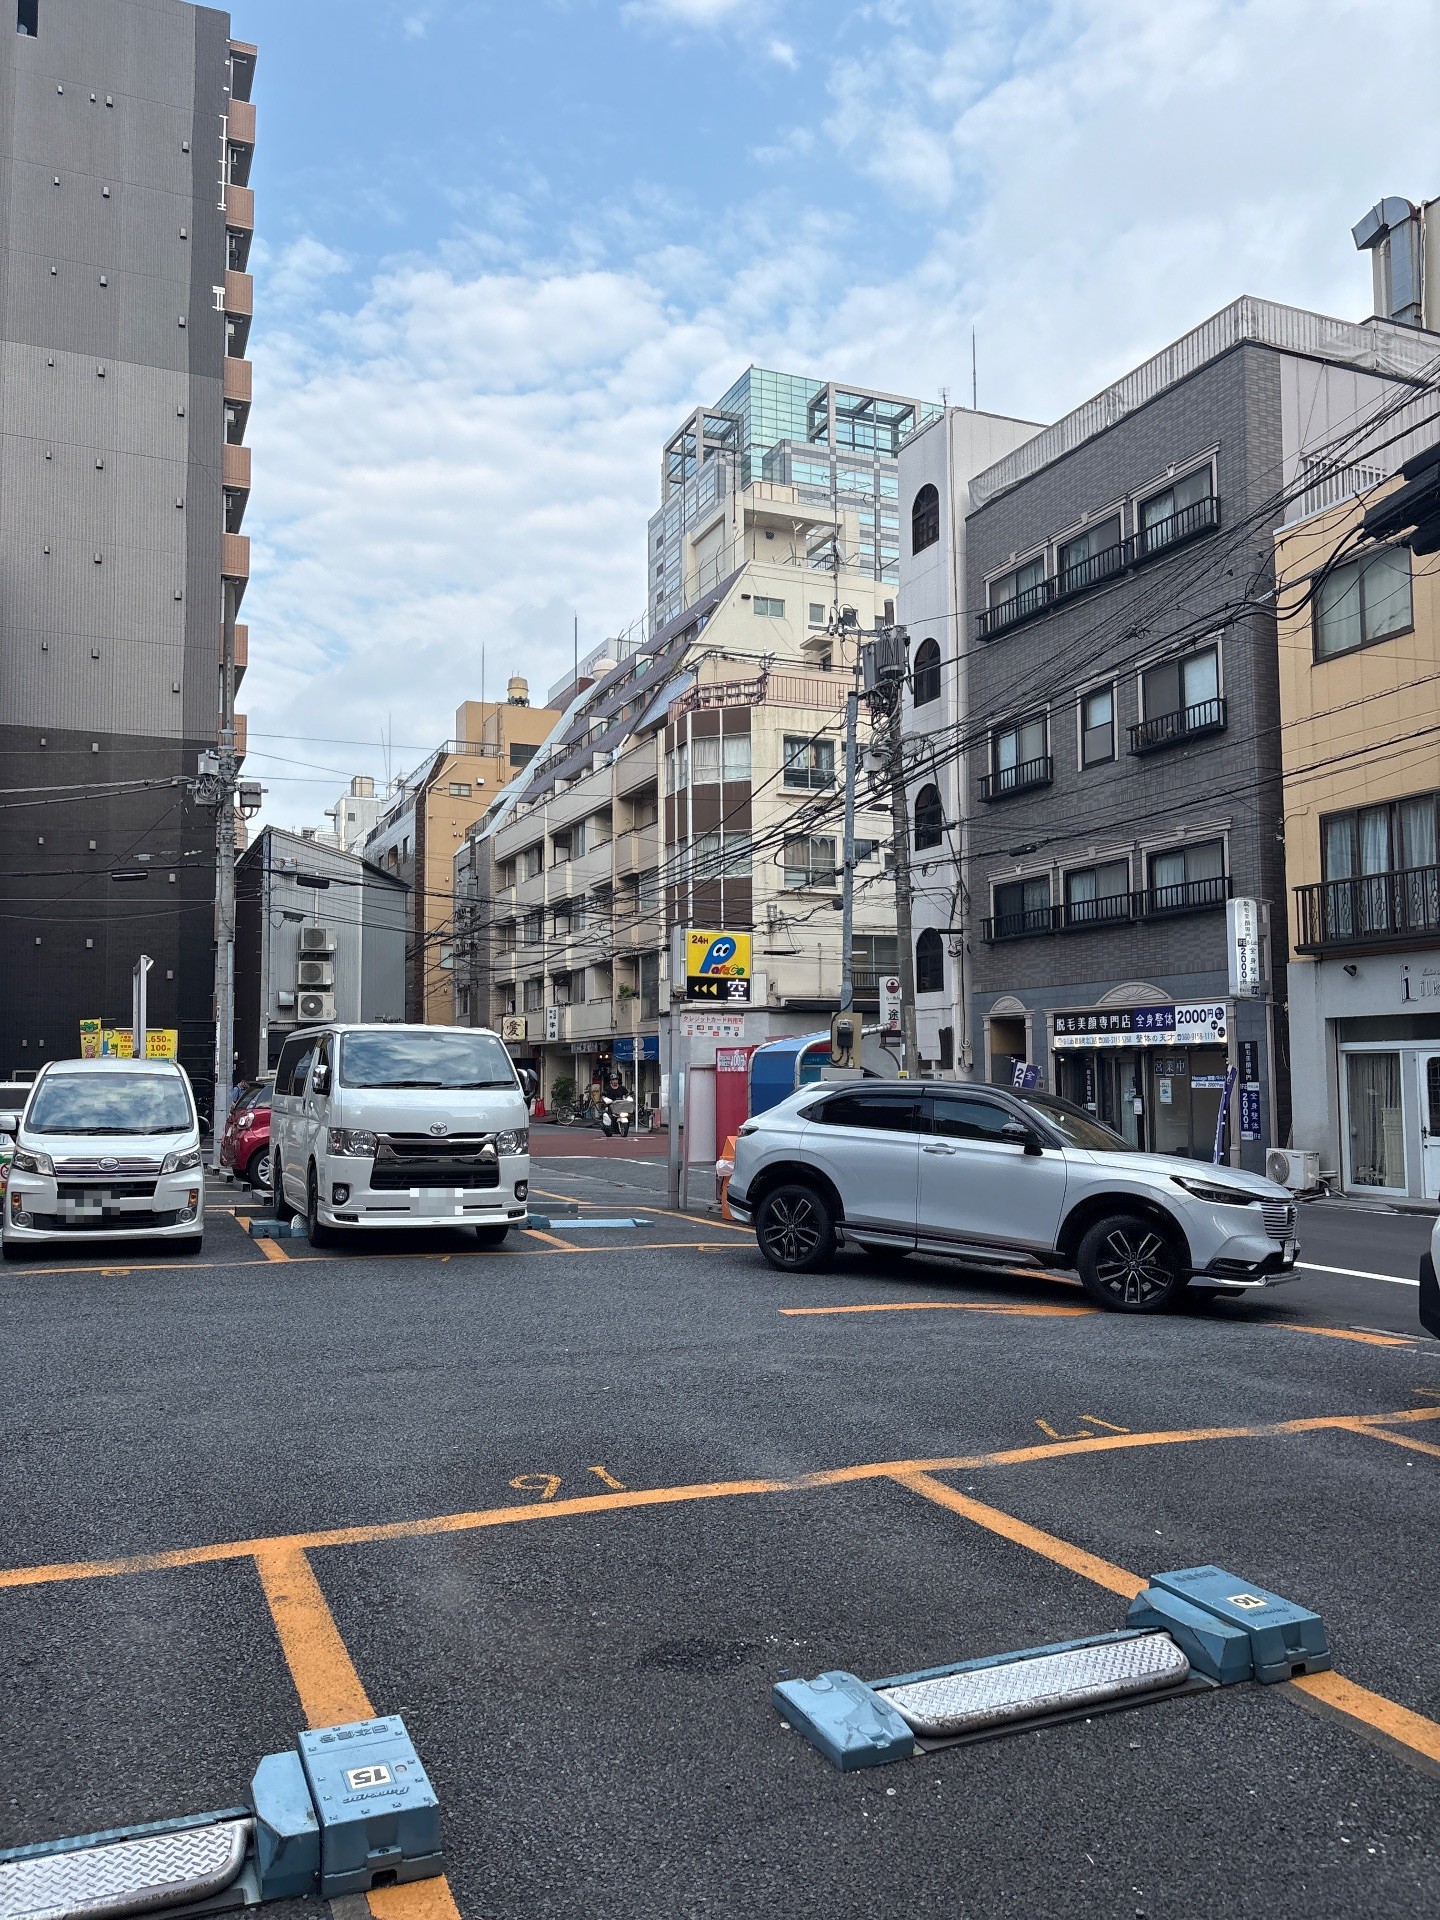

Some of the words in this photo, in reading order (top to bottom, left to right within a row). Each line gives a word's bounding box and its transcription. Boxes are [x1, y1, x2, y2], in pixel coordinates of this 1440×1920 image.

[692, 935, 708, 945] 24H
[727, 979, 747, 1000] 空
[683, 1015, 743, 1024] クレジットカード利用可
[888, 1002, 899, 1021] 一途
[1135, 1012, 1174, 1027] 全身整体
[1177, 1009, 1213, 1024] 2000円
[507, 1020, 521, 1037] 愛
[1056, 1014, 1131, 1031] 脱毛美顔専門店
[352, 1767, 387, 1786] 15
